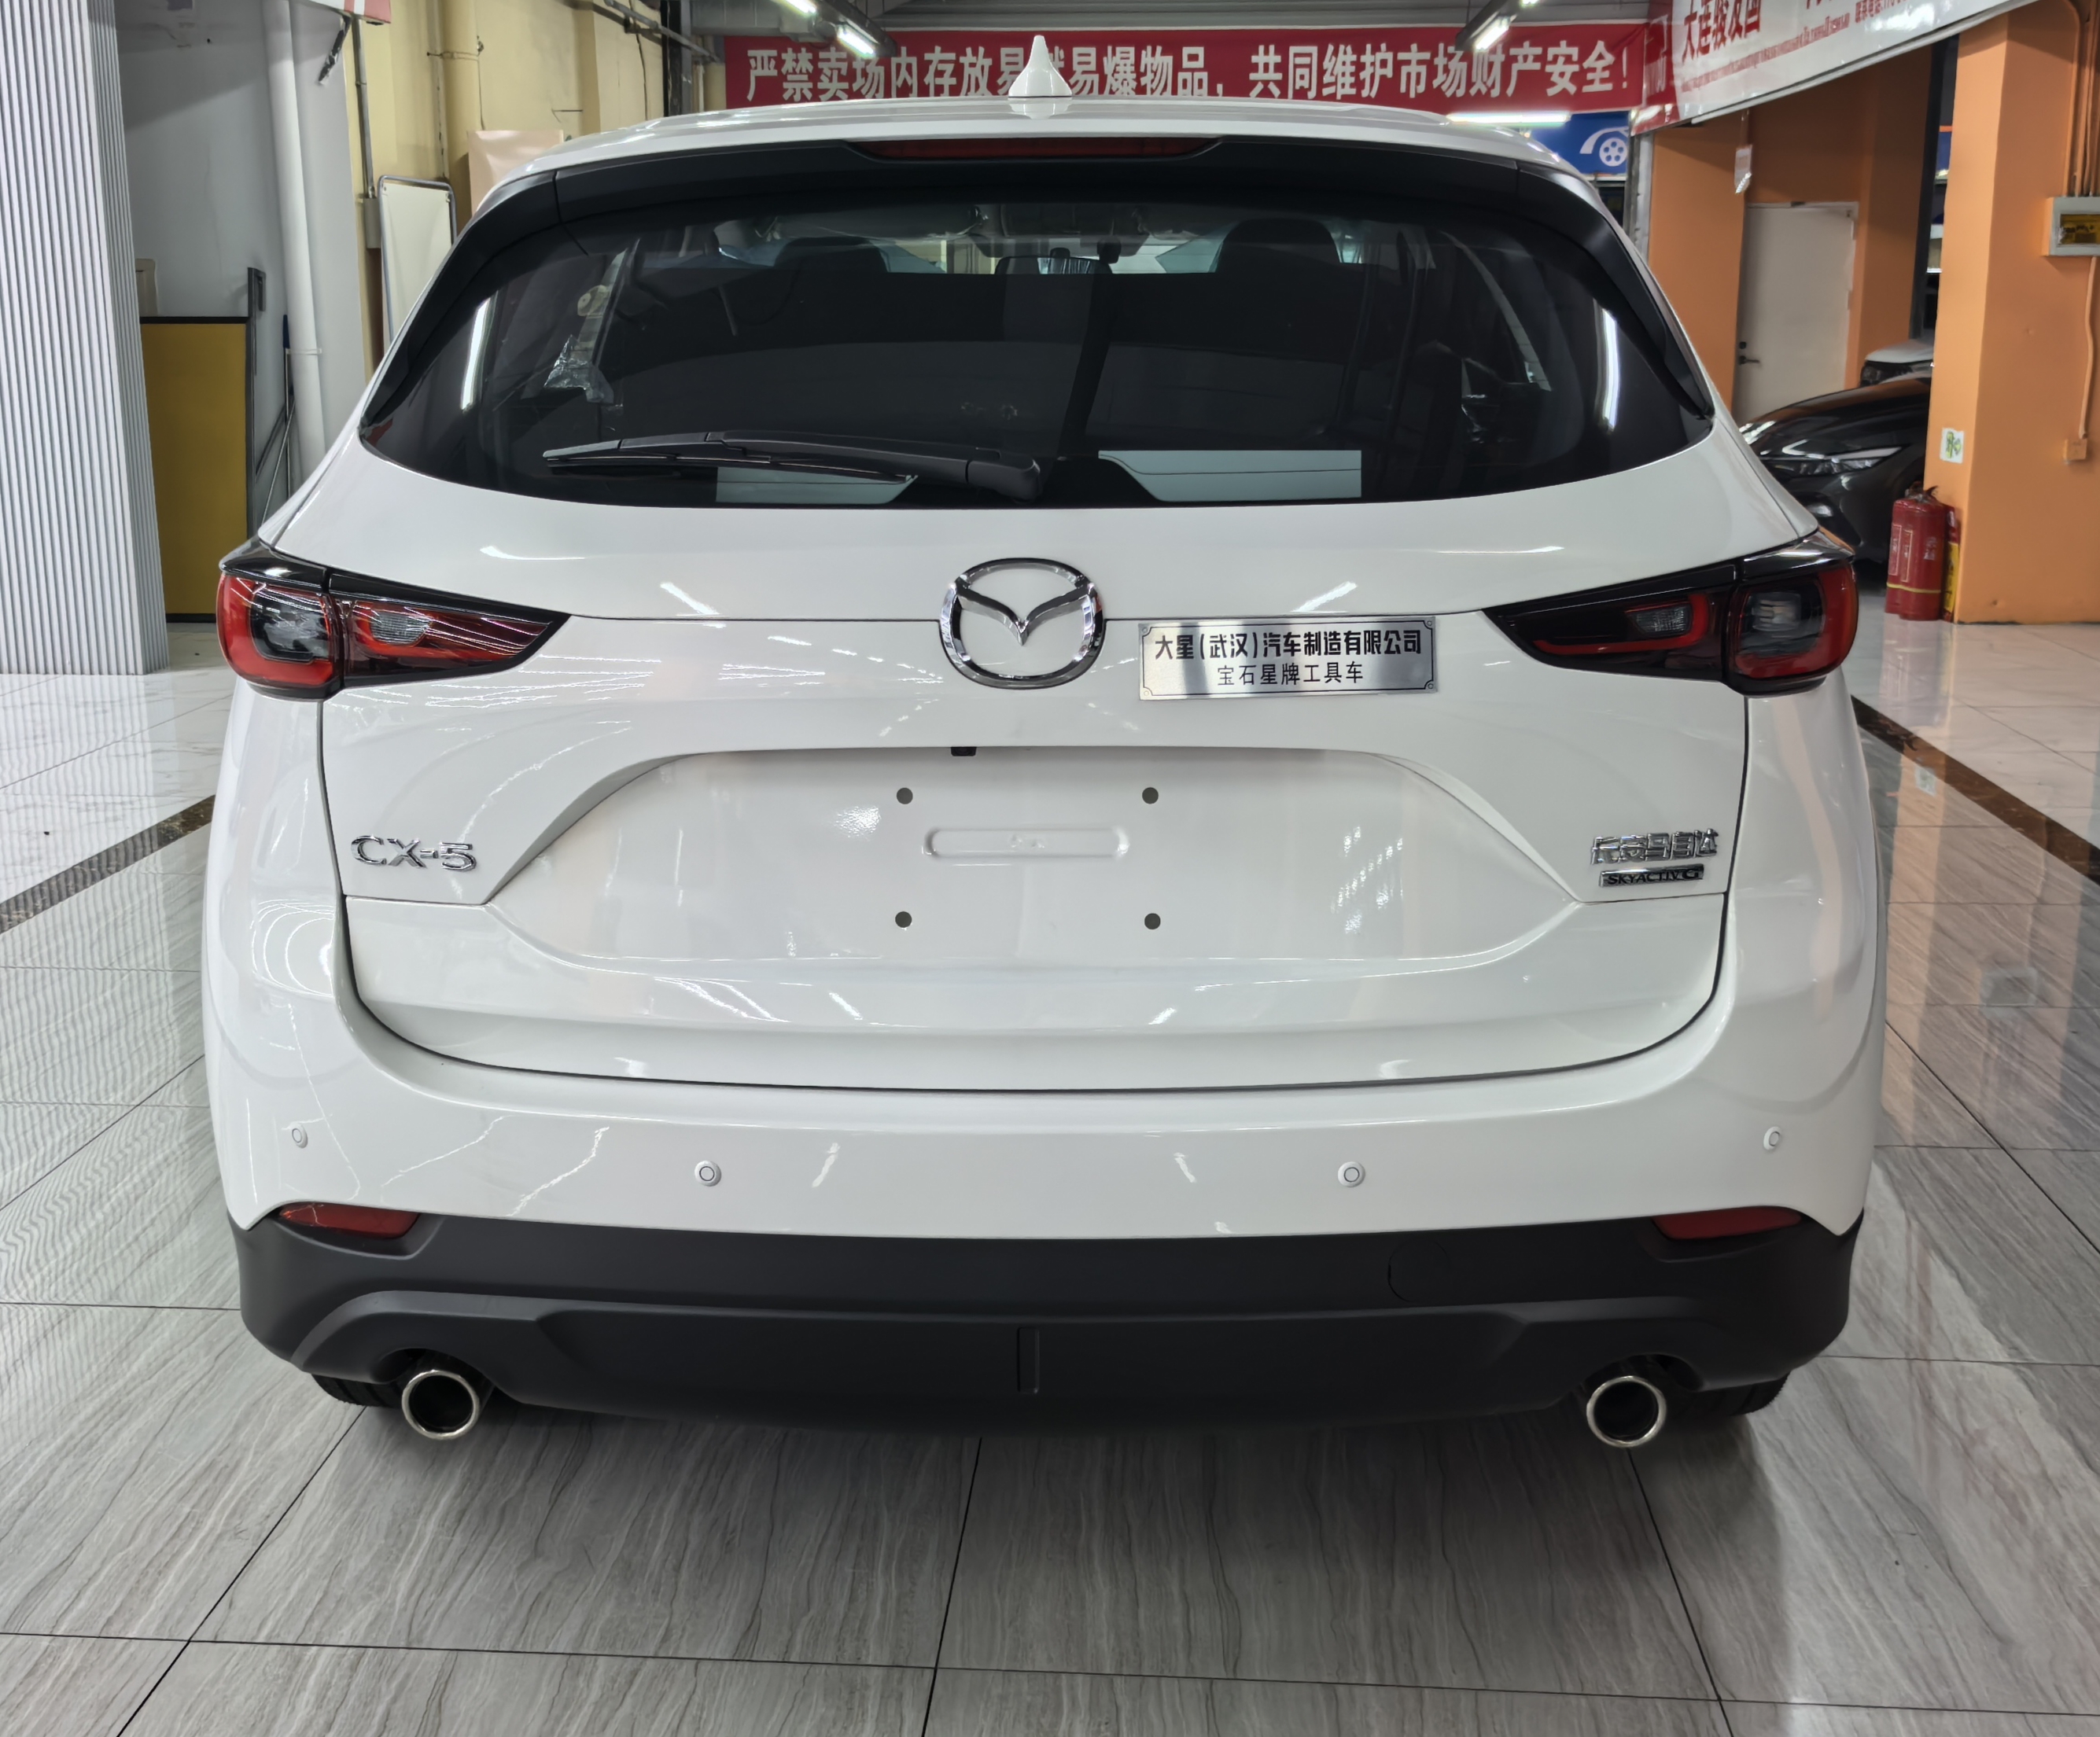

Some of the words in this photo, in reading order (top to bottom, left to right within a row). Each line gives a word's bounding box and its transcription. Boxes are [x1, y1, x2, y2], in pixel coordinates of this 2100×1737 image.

[747, 40, 1627, 102] 严禁卖场内存放易易爆物品，共同维护市场财产安全！
[1218, 661, 1363, 686] 宝石星牌工具车
[351, 835, 477, 872] CX-5
